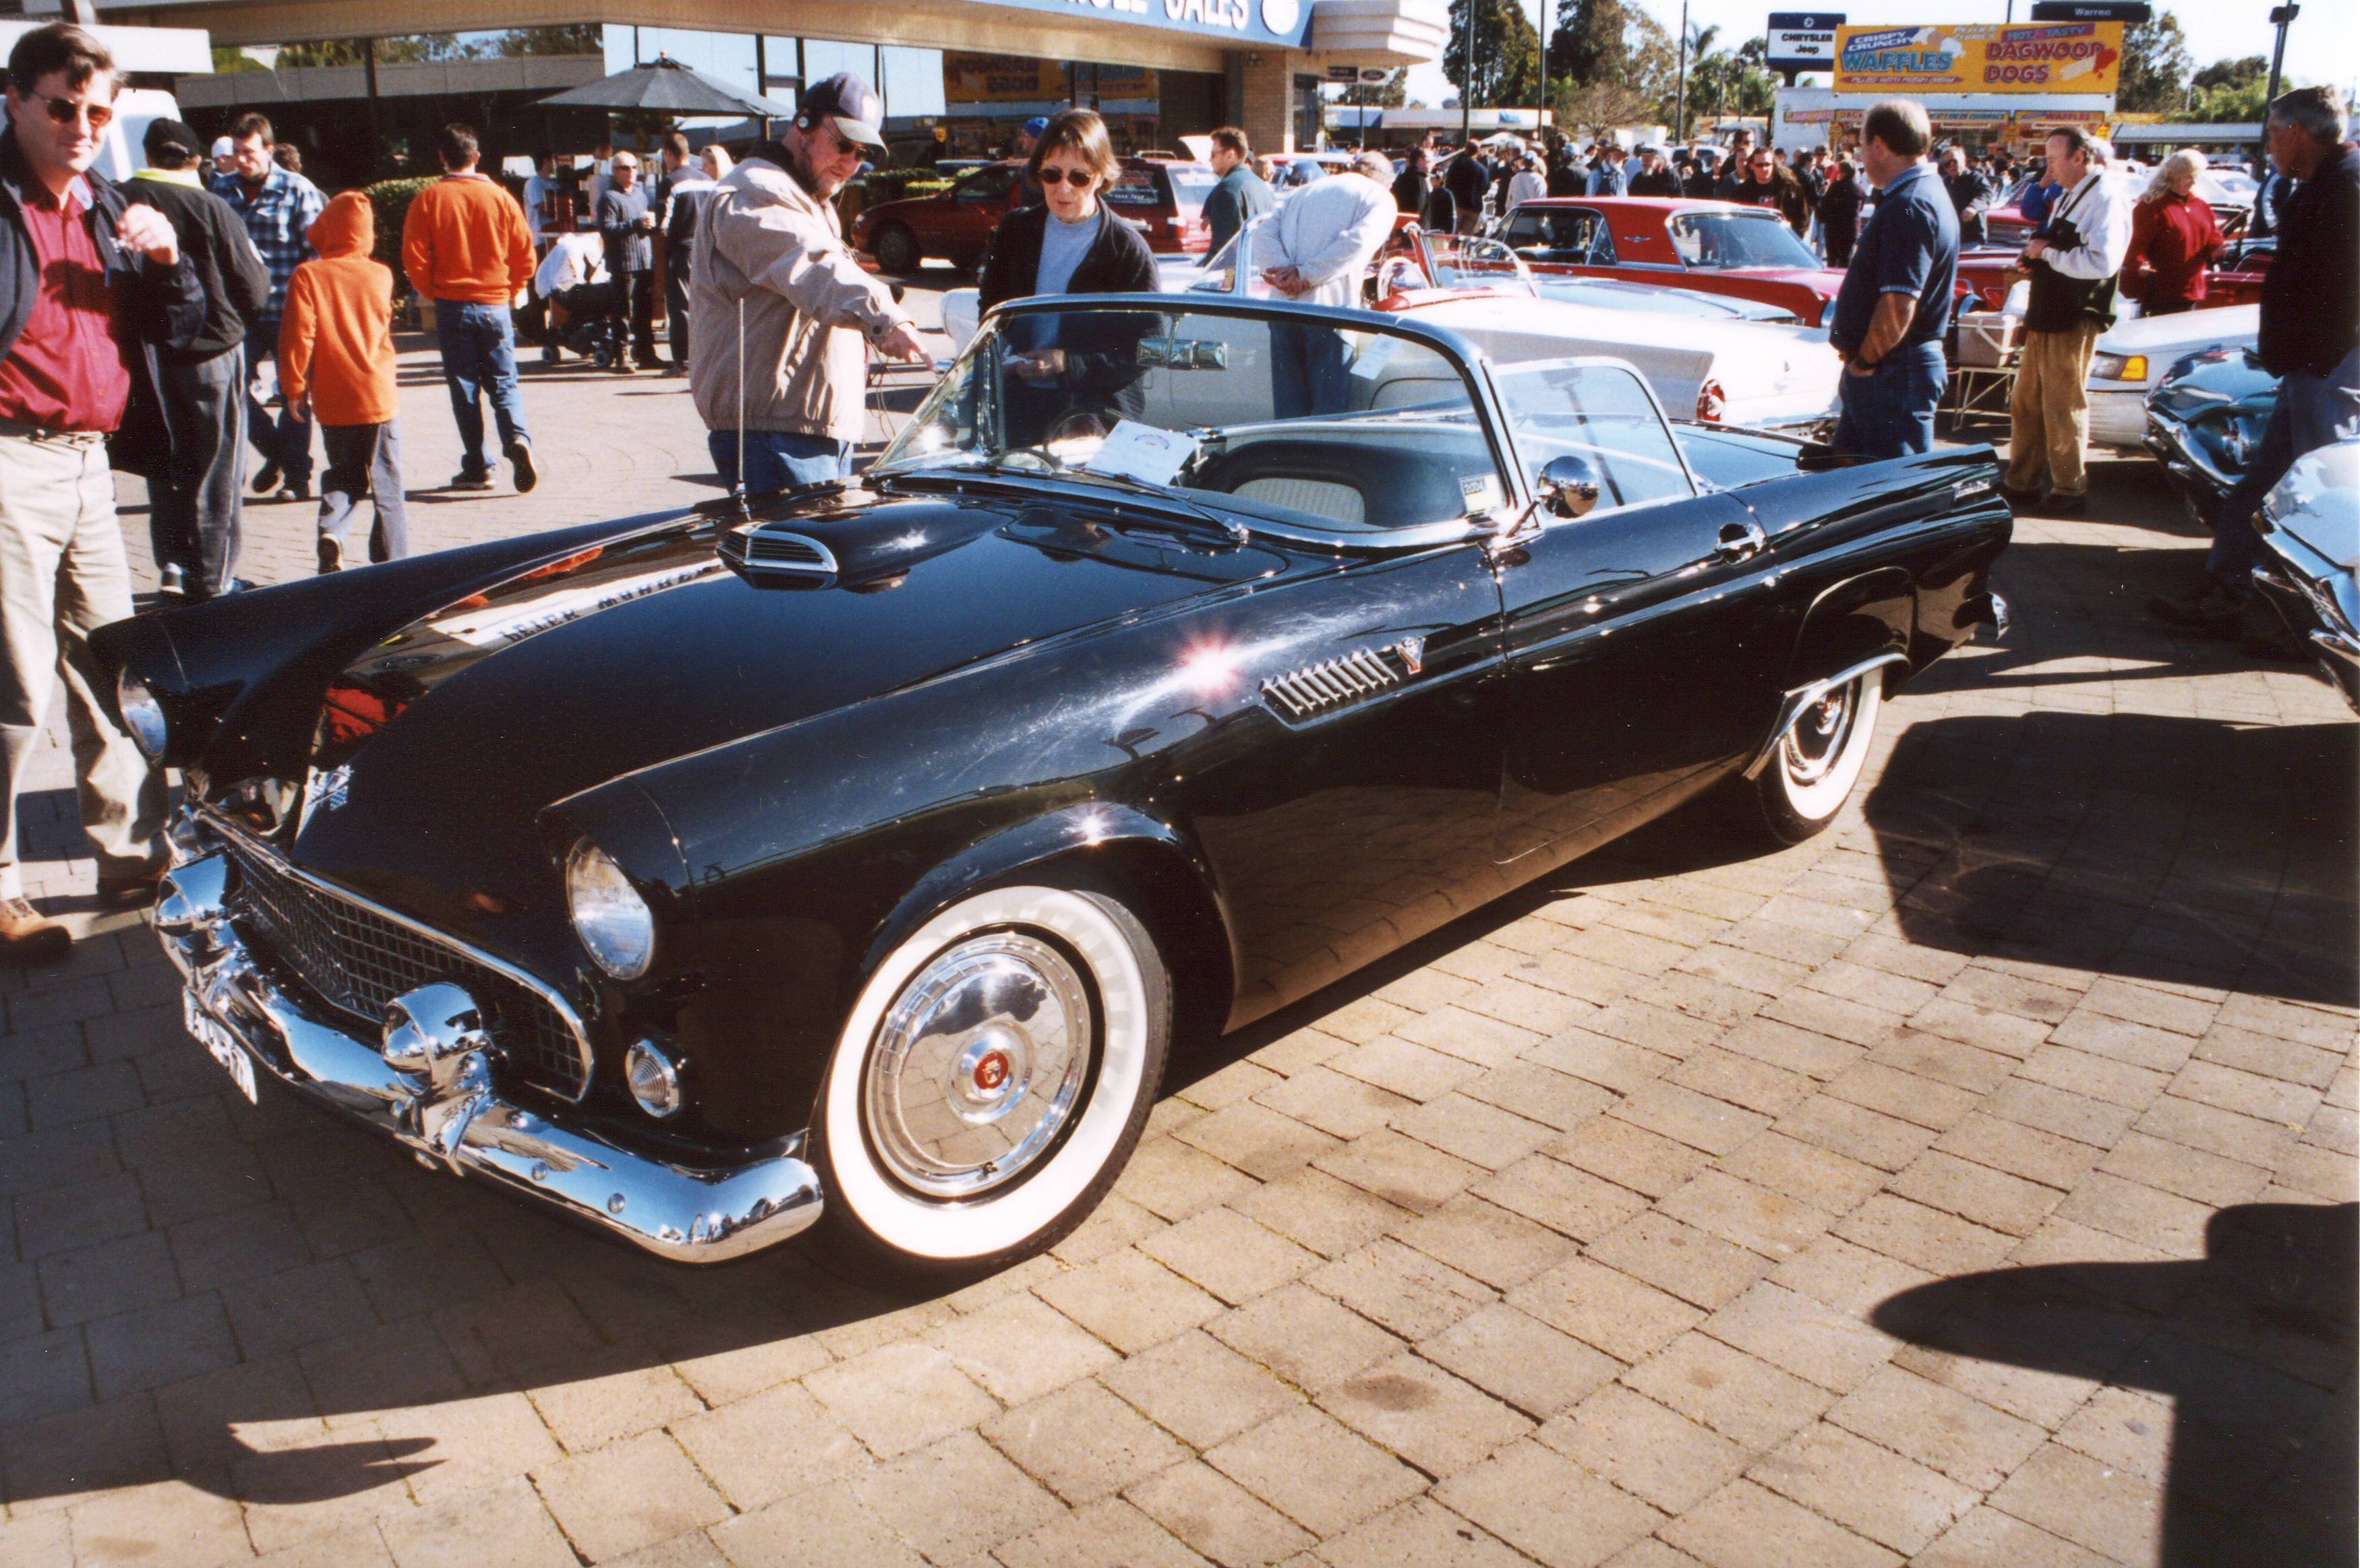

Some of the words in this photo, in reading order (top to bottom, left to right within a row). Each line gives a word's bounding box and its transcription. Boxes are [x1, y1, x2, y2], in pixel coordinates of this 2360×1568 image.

[2074, 7, 2111, 16] Warren
[1781, 33, 1833, 41] CHRYSLER
[1848, 36, 1914, 52] CRUNCHY
[1855, 31, 1907, 44] CRISPY
[1795, 44, 1819, 55] Jeep
[1984, 40, 2105, 61] DAGWOOD
[1841, 51, 1953, 72] WAFFLES
[1984, 63, 2051, 84] DOGS
